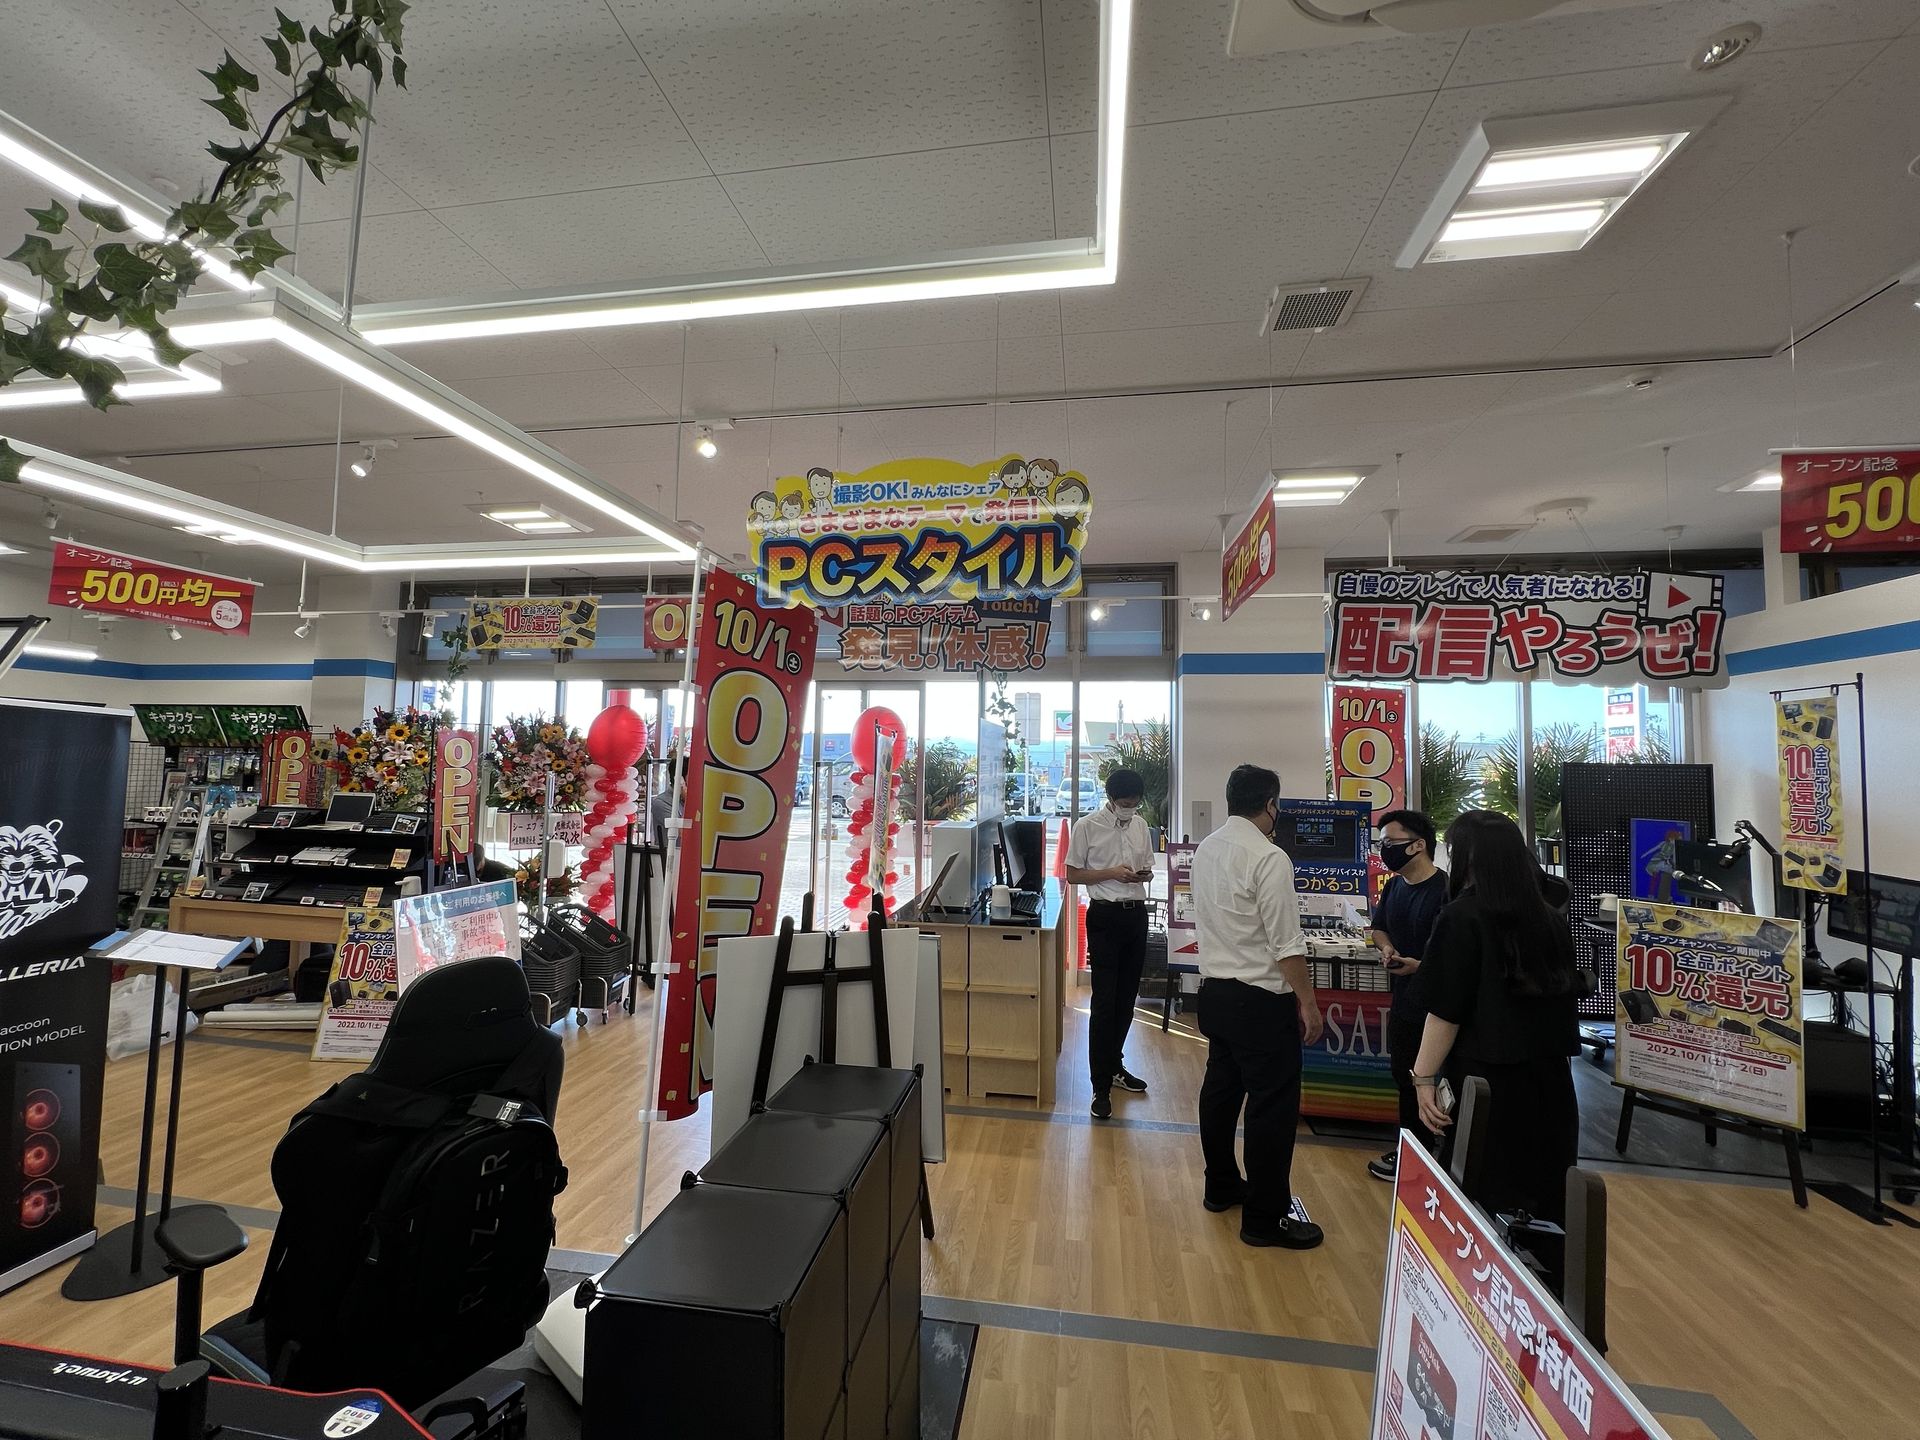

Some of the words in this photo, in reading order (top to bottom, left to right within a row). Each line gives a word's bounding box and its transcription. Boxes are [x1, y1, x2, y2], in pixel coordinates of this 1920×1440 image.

[1796, 456, 1899, 473] オープン記念
[833, 482, 908, 504] 撮影OK!
[912, 482, 1001, 499] みんなにシェア
[800, 498, 1038, 533] さまざまなテーマで発信!
[66, 548, 133, 570] オープン記念
[767, 533, 1075, 599] PCスタイル
[81, 569, 241, 607] 500円均一
[1338, 574, 1644, 599] 自慢のプレイで人気者になれる!
[850, 605, 981, 624] 話題のPCアイテム
[1336, 604, 1721, 678] 配信やろうぜ!
[149, 712, 204, 722] キャラクター
[168, 724, 196, 734] グッズ
[231, 712, 288, 723] キャラクター
[440, 737, 473, 857] OPEN
[1814, 745, 1833, 835] 全品ポイント
[1294, 866, 1367, 876] ゲーミングデバイスが
[1641, 933, 1773, 959] オープンキャンペーン期間中
[1677, 950, 1791, 983] 全品ポイント
[1625, 944, 1790, 1018] 10%還元
[36, 1025, 86, 1045] MODEL
[1424, 1185, 1595, 1436] オープン記念特価
